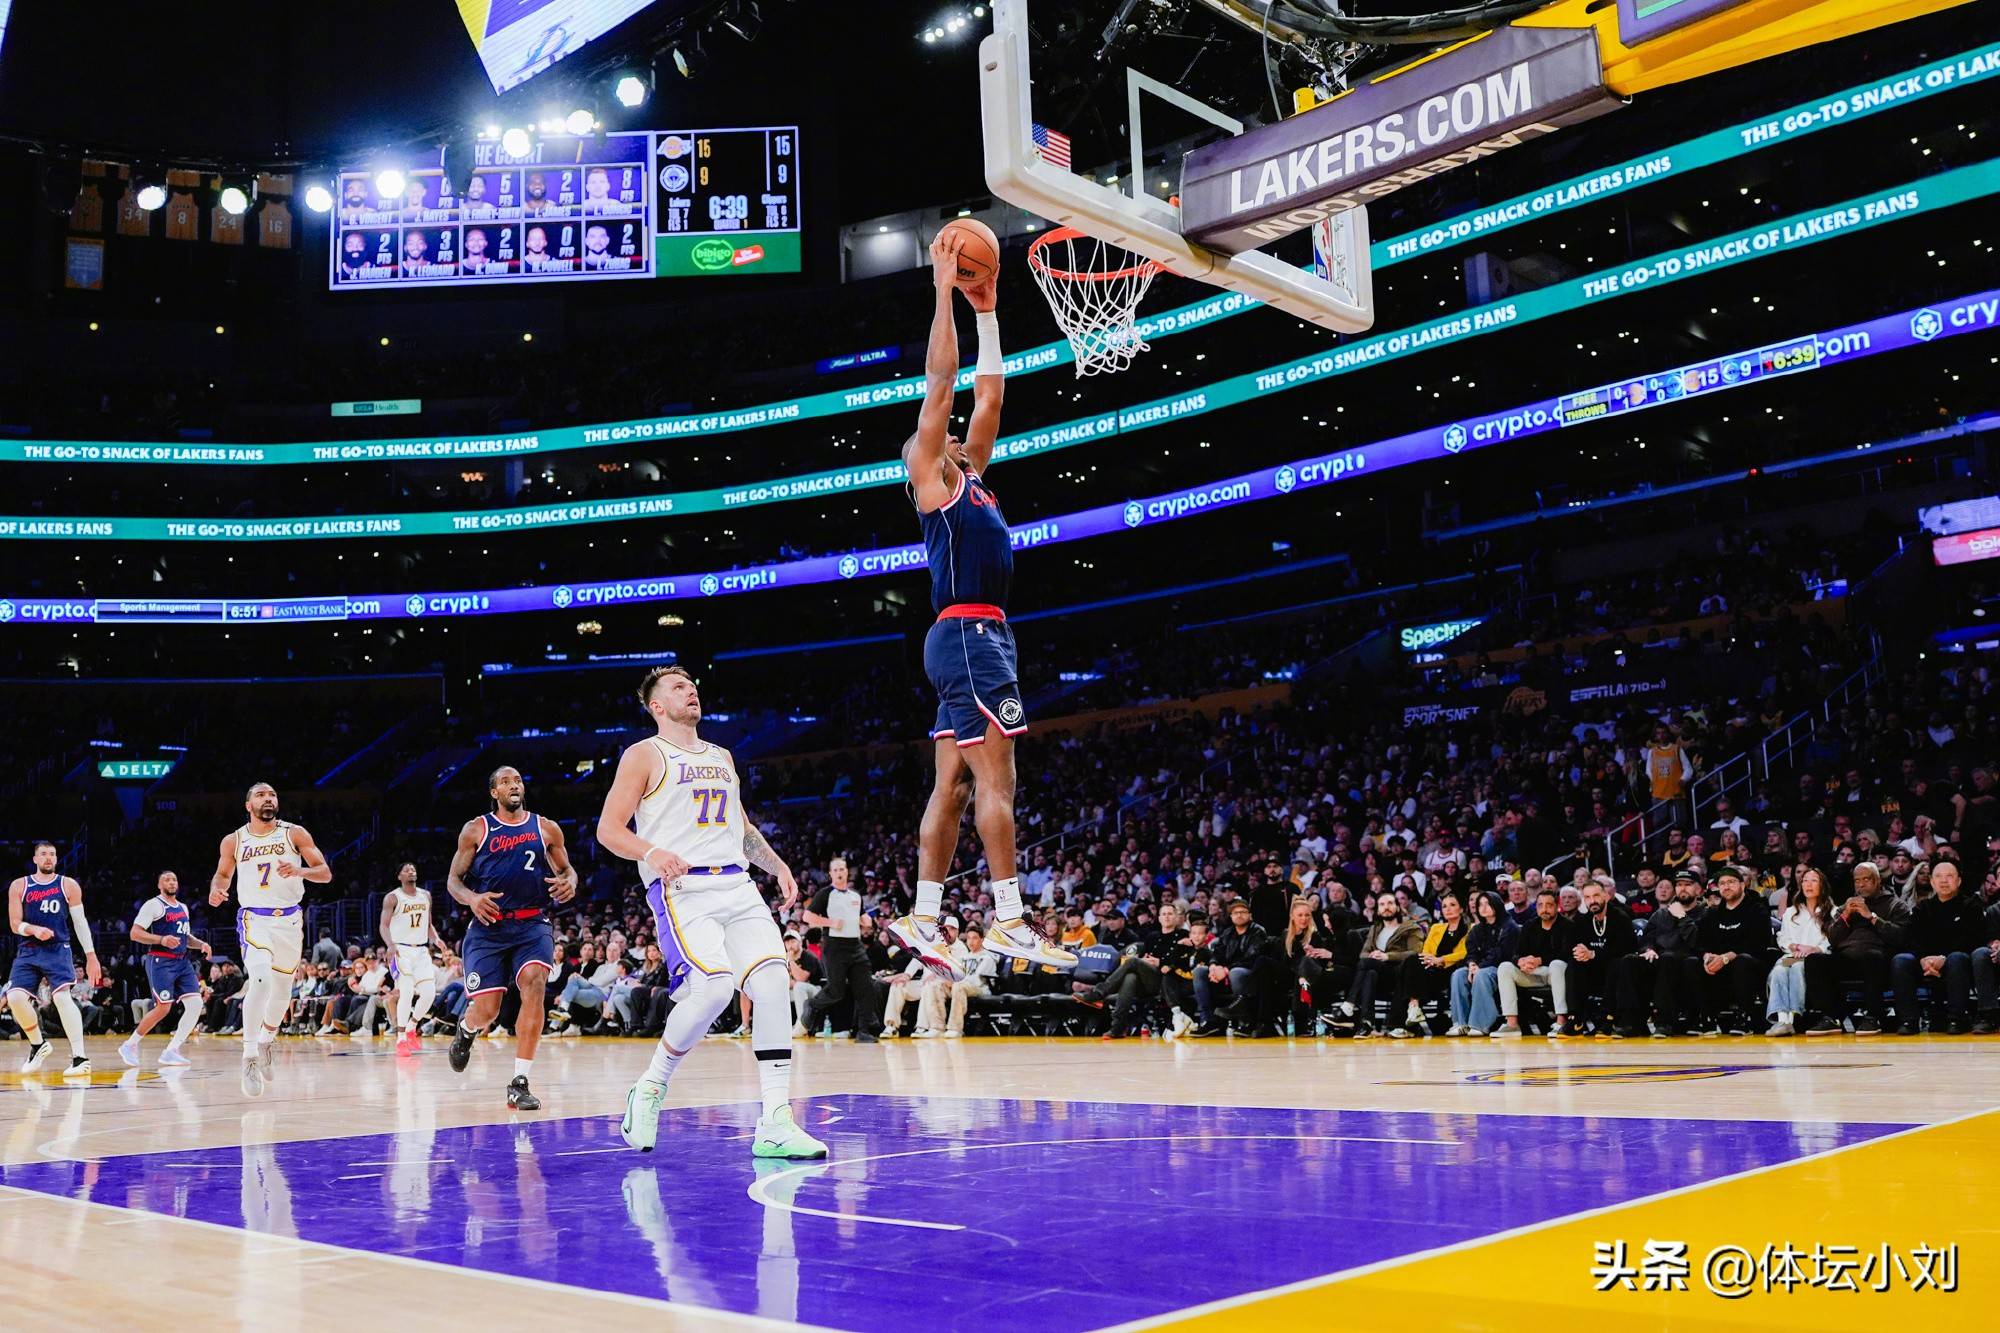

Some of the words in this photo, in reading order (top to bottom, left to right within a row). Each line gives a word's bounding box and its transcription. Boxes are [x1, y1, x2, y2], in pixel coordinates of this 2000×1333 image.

[1741, 121, 1780, 146] THE
[1783, 100, 1848, 132] GO-TO
[1851, 76, 1922, 112] SNACK
[1926, 65, 1955, 87] OF
[1958, 50, 2000, 79] LAK
[696, 138, 712, 159] 15
[774, 135, 791, 156] 15
[1231, 62, 1532, 214] LAKERS.COM
[500, 173, 512, 195] 5
[560, 171, 573, 192] 2
[622, 169, 633, 190] 8
[699, 166, 709, 186] 9
[777, 164, 788, 184] 9
[708, 194, 748, 220] 6:39
[1387, 237, 1418, 258] THE
[1419, 221, 1471, 248] GO-TO
[1473, 201, 1530, 231] SNACK
[1532, 193, 1554, 211] OF
[1557, 171, 1623, 205] LAKERS
[1625, 156, 1671, 183] FANS
[378, 232, 391, 253] 2
[439, 230, 452, 250] 3
[500, 228, 513, 249] 2
[560, 225, 574, 247] 0
[622, 223, 634, 244] 2
[696, 247, 731, 262] bibigo
[1583, 275, 1619, 298] THE
[1621, 258, 1681, 287] GO-TO
[1684, 238, 1750, 270] SNACK
[1753, 229, 1779, 250] OF
[1783, 207, 1861, 243] LAKERS
[1865, 191, 1919, 220] FANS
[1177, 301, 1223, 328] SNACK
[1223, 293, 1243, 311] OF
[1950, 298, 1999, 327] cry
[860, 350, 888, 363] ULTRA
[1256, 372, 1284, 390] THE
[1286, 358, 1334, 381] GO-TO
[1334, 341, 1386, 371] SNACK
[1388, 333, 1410, 354] OF
[1411, 318, 1471, 347] LAKERS
[1474, 304, 1517, 330] FANS
[1773, 344, 1815, 370] 6:39
[844, 391, 870, 406] THE
[872, 383, 915, 402] GO-TO
[1025, 348, 1057, 368] FANS
[1698, 368, 1719, 387] 15
[1740, 360, 1752, 377] 9
[1572, 392, 1597, 408] FREE
[584, 429, 609, 443] THE
[611, 424, 653, 439] GO-TO
[655, 420, 699, 435] SNACK
[701, 417, 718, 430] OF
[720, 411, 766, 428] LAKERS
[768, 404, 799, 420] FANS
[1472, 403, 1562, 441] crypto.c
[1564, 404, 1608, 422] THROWS
[990, 444, 1008, 459] HE
[1009, 434, 1050, 454] GO-TO
[1051, 422, 1095, 444] SNACK
[1097, 417, 1115, 433] OF
[1119, 405, 1170, 428] LAKERS
[1172, 394, 1206, 416] FANS
[24, 445, 51, 458] THE
[54, 446, 100, 458] GO-TO
[102, 447, 150, 459] SNACK
[152, 448, 171, 459] OF
[173, 448, 226, 460] LAKERS
[229, 449, 264, 460] FANS
[313, 447, 339, 459] THE
[341, 445, 384, 458] GO-TO
[386, 443, 431, 456] SNACK
[433, 442, 452, 454] OF
[454, 440, 503, 454] LAKERS
[505, 436, 539, 451] FANS
[723, 491, 747, 505] THE
[749, 485, 789, 501] GO-TO
[791, 477, 833, 495] SNACK
[834, 474, 851, 487] OF
[853, 465, 903, 485] LAKERS
[1148, 479, 1251, 520] crypto.com
[453, 516, 479, 529] THE
[481, 513, 523, 528] GO-TO
[525, 509, 567, 524] SNACK
[570, 507, 587, 519] OF
[588, 502, 637, 518] LAKERS
[639, 499, 673, 513] FANS
[0, 522, 17, 534] OF
[19, 522, 73, 535] LAKERS
[76, 523, 113, 535] FANS
[167, 524, 195, 536] THE
[198, 524, 244, 536] GO-TO
[246, 524, 291, 536] SNACK
[293, 523, 311, 534] OF
[313, 521, 364, 534] LAKERS
[366, 519, 401, 532] FANS
[576, 579, 676, 603] crypto.com
[20, 602, 95, 621] crypto.c
[119, 601, 147, 614] Sports
[148, 601, 201, 613] Management
[230, 604, 258, 618] 6:51
[1630, 681, 1651, 695] 710
[119, 764, 171, 776] DELTA
[677, 762, 732, 785] LAKERS
[692, 788, 728, 826] 77
[1881, 801, 1900, 815] FAN
[239, 842, 286, 863] LAKERS
[489, 832, 539, 853] Clippers
[523, 850, 536, 871] 2
[257, 862, 272, 888] 7
[25, 886, 60, 904] Clippers
[39, 899, 61, 914] 40
[402, 903, 427, 914] LAKERS
[176, 920, 191, 936] 24
[410, 913, 422, 928] 17
